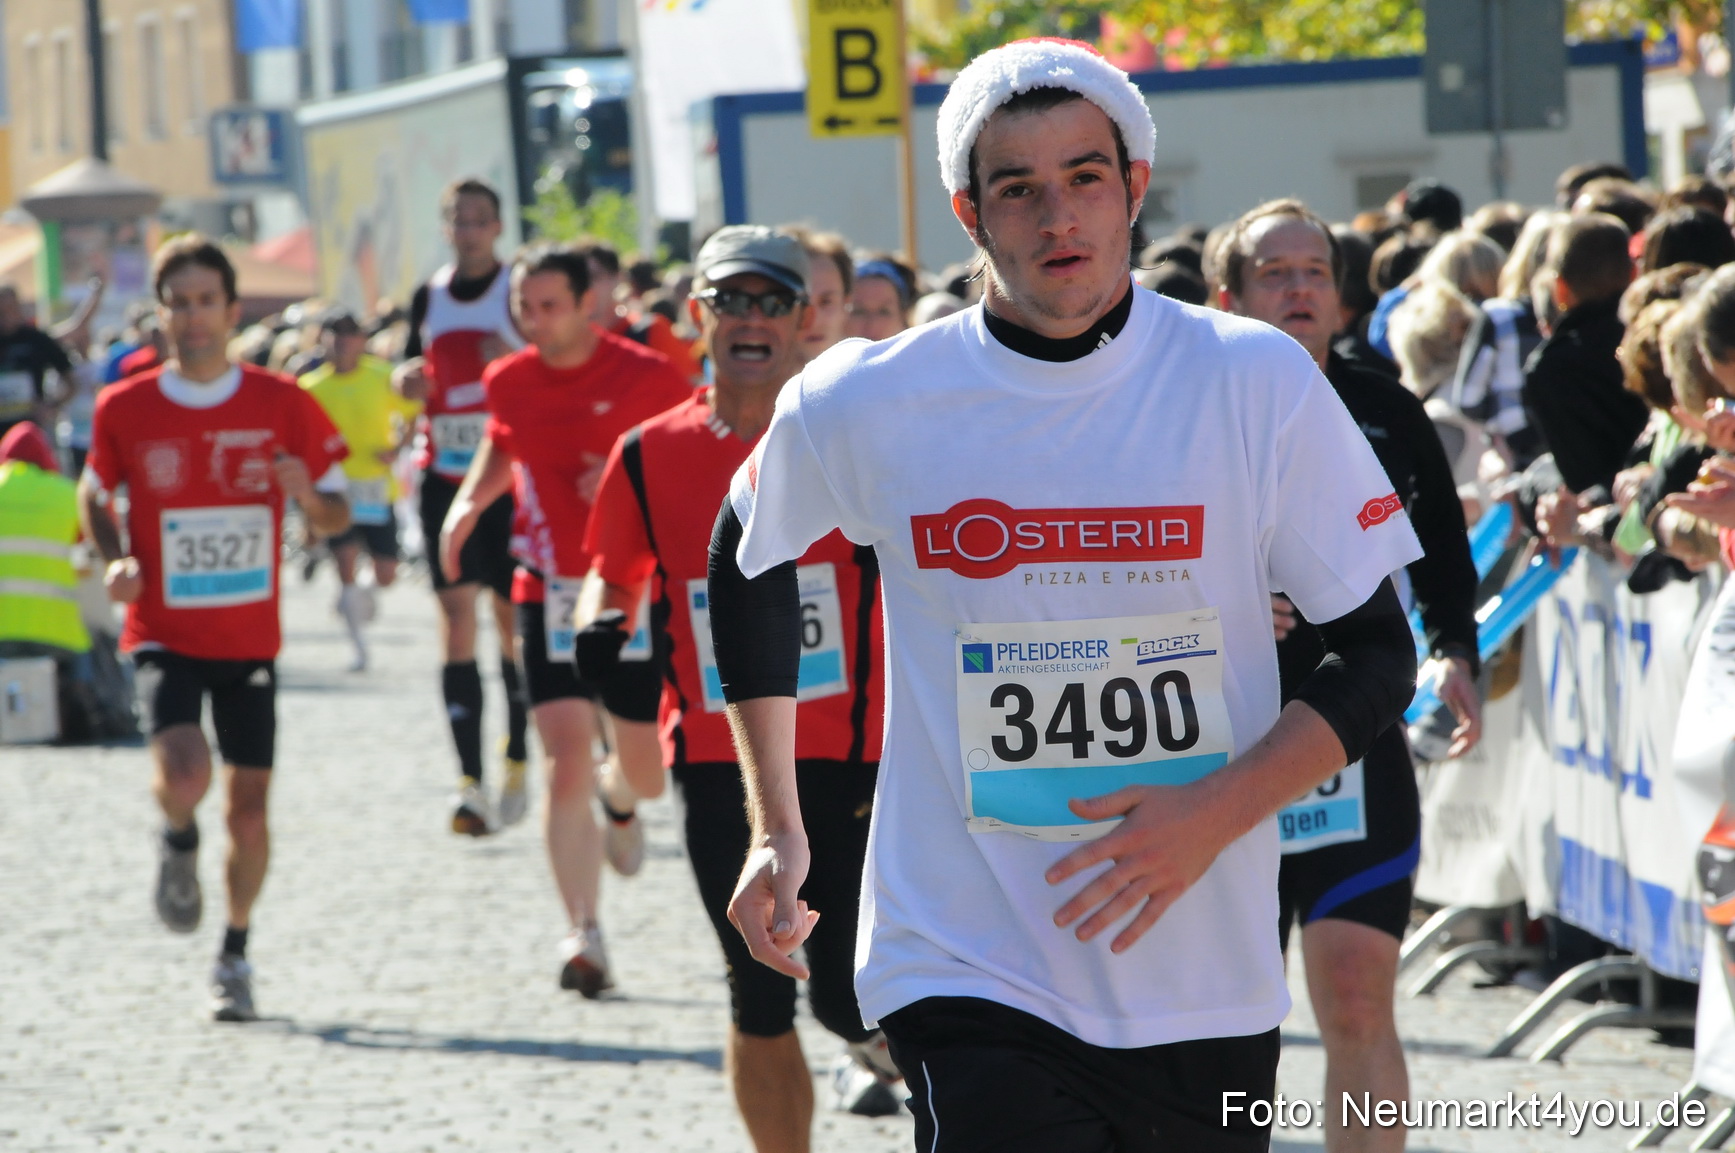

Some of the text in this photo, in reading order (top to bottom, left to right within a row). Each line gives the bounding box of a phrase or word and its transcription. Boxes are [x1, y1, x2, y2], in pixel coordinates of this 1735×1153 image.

[835, 28, 883, 99] B
[177, 533, 262, 571] 3527
[1025, 569, 1190, 585] PIZZA E PASTA
[997, 634, 1200, 661] PFLEIDERER BOCK
[998, 661, 1110, 674] AKTIENGESELLSCHAFT
[990, 670, 1200, 762] 3490
